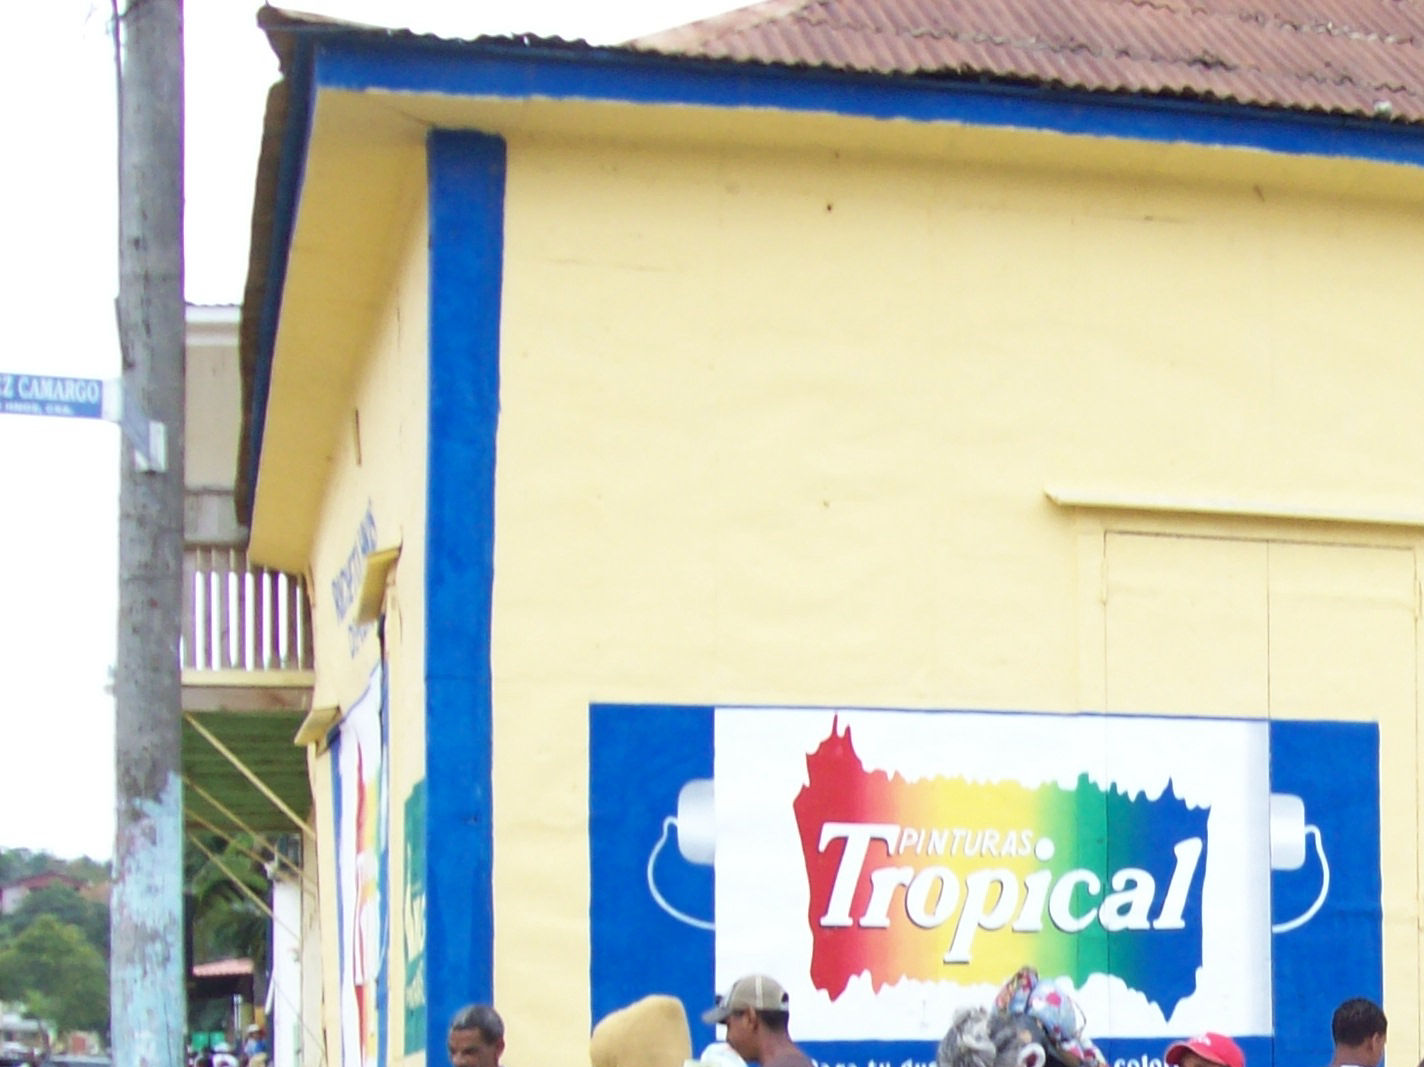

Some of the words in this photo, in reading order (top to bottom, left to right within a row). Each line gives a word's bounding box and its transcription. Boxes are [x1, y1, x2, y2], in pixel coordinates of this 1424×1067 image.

[18, 376, 100, 405] CAMARGO
[898, 826, 1034, 858] PINTURAS
[818, 822, 1203, 963] Tropical
